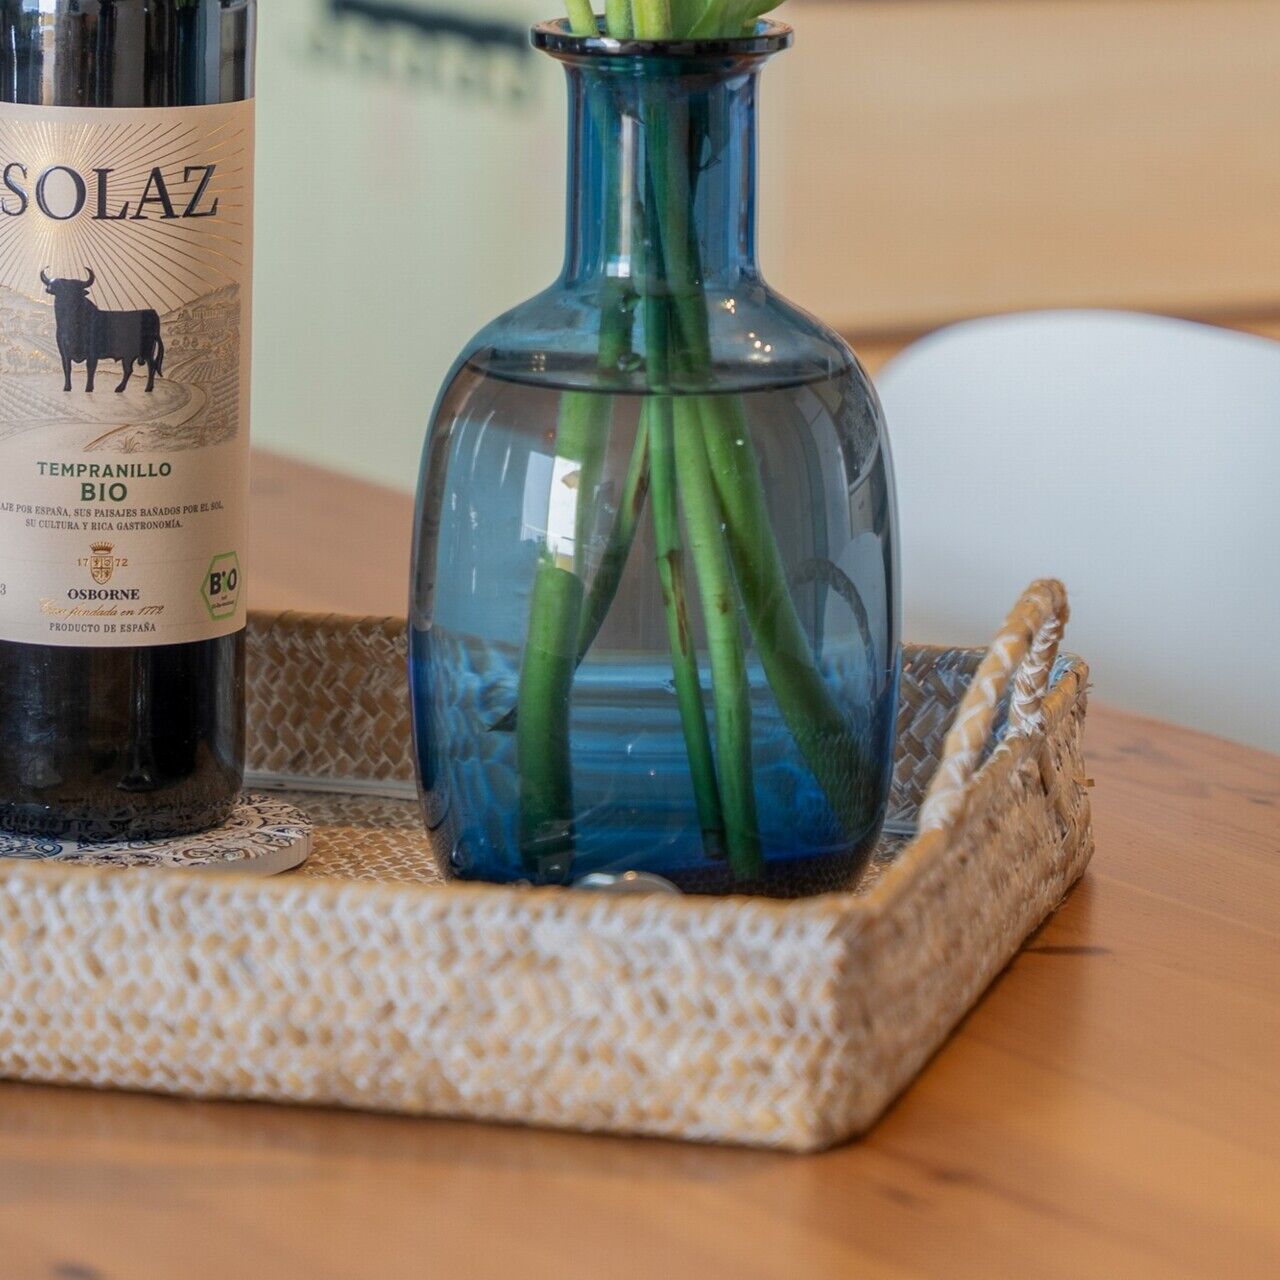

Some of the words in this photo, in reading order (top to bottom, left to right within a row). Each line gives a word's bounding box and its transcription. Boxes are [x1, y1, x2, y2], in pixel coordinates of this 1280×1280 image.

[1, 162, 219, 220] SOLAZ
[37, 461, 172, 479] TEMPRANILLO
[80, 482, 128, 502] BIO
[16, 504, 33, 514] POR
[35, 505, 71, 518] ESPAÑA,
[73, 508, 92, 518] SUS
[94, 508, 138, 518] PAISAJES
[140, 506, 181, 517] BAÑADOS
[182, 503, 199, 515] POR
[200, 502, 210, 513] EL
[25, 518, 37, 528] SU
[38, 520, 80, 531] CULTURA
[82, 521, 89, 531] Y
[91, 521, 114, 531] RICA
[116, 519, 183, 532] GASTRONOMÍA.
[77, 558, 88, 567] 17
[115, 557, 129, 567] 72
[67, 588, 140, 601] OSBORNE
[49, 622, 101, 633] PRODUCTO
[103, 623, 117, 633] DE
[120, 622, 157, 633] ESPAÑA
